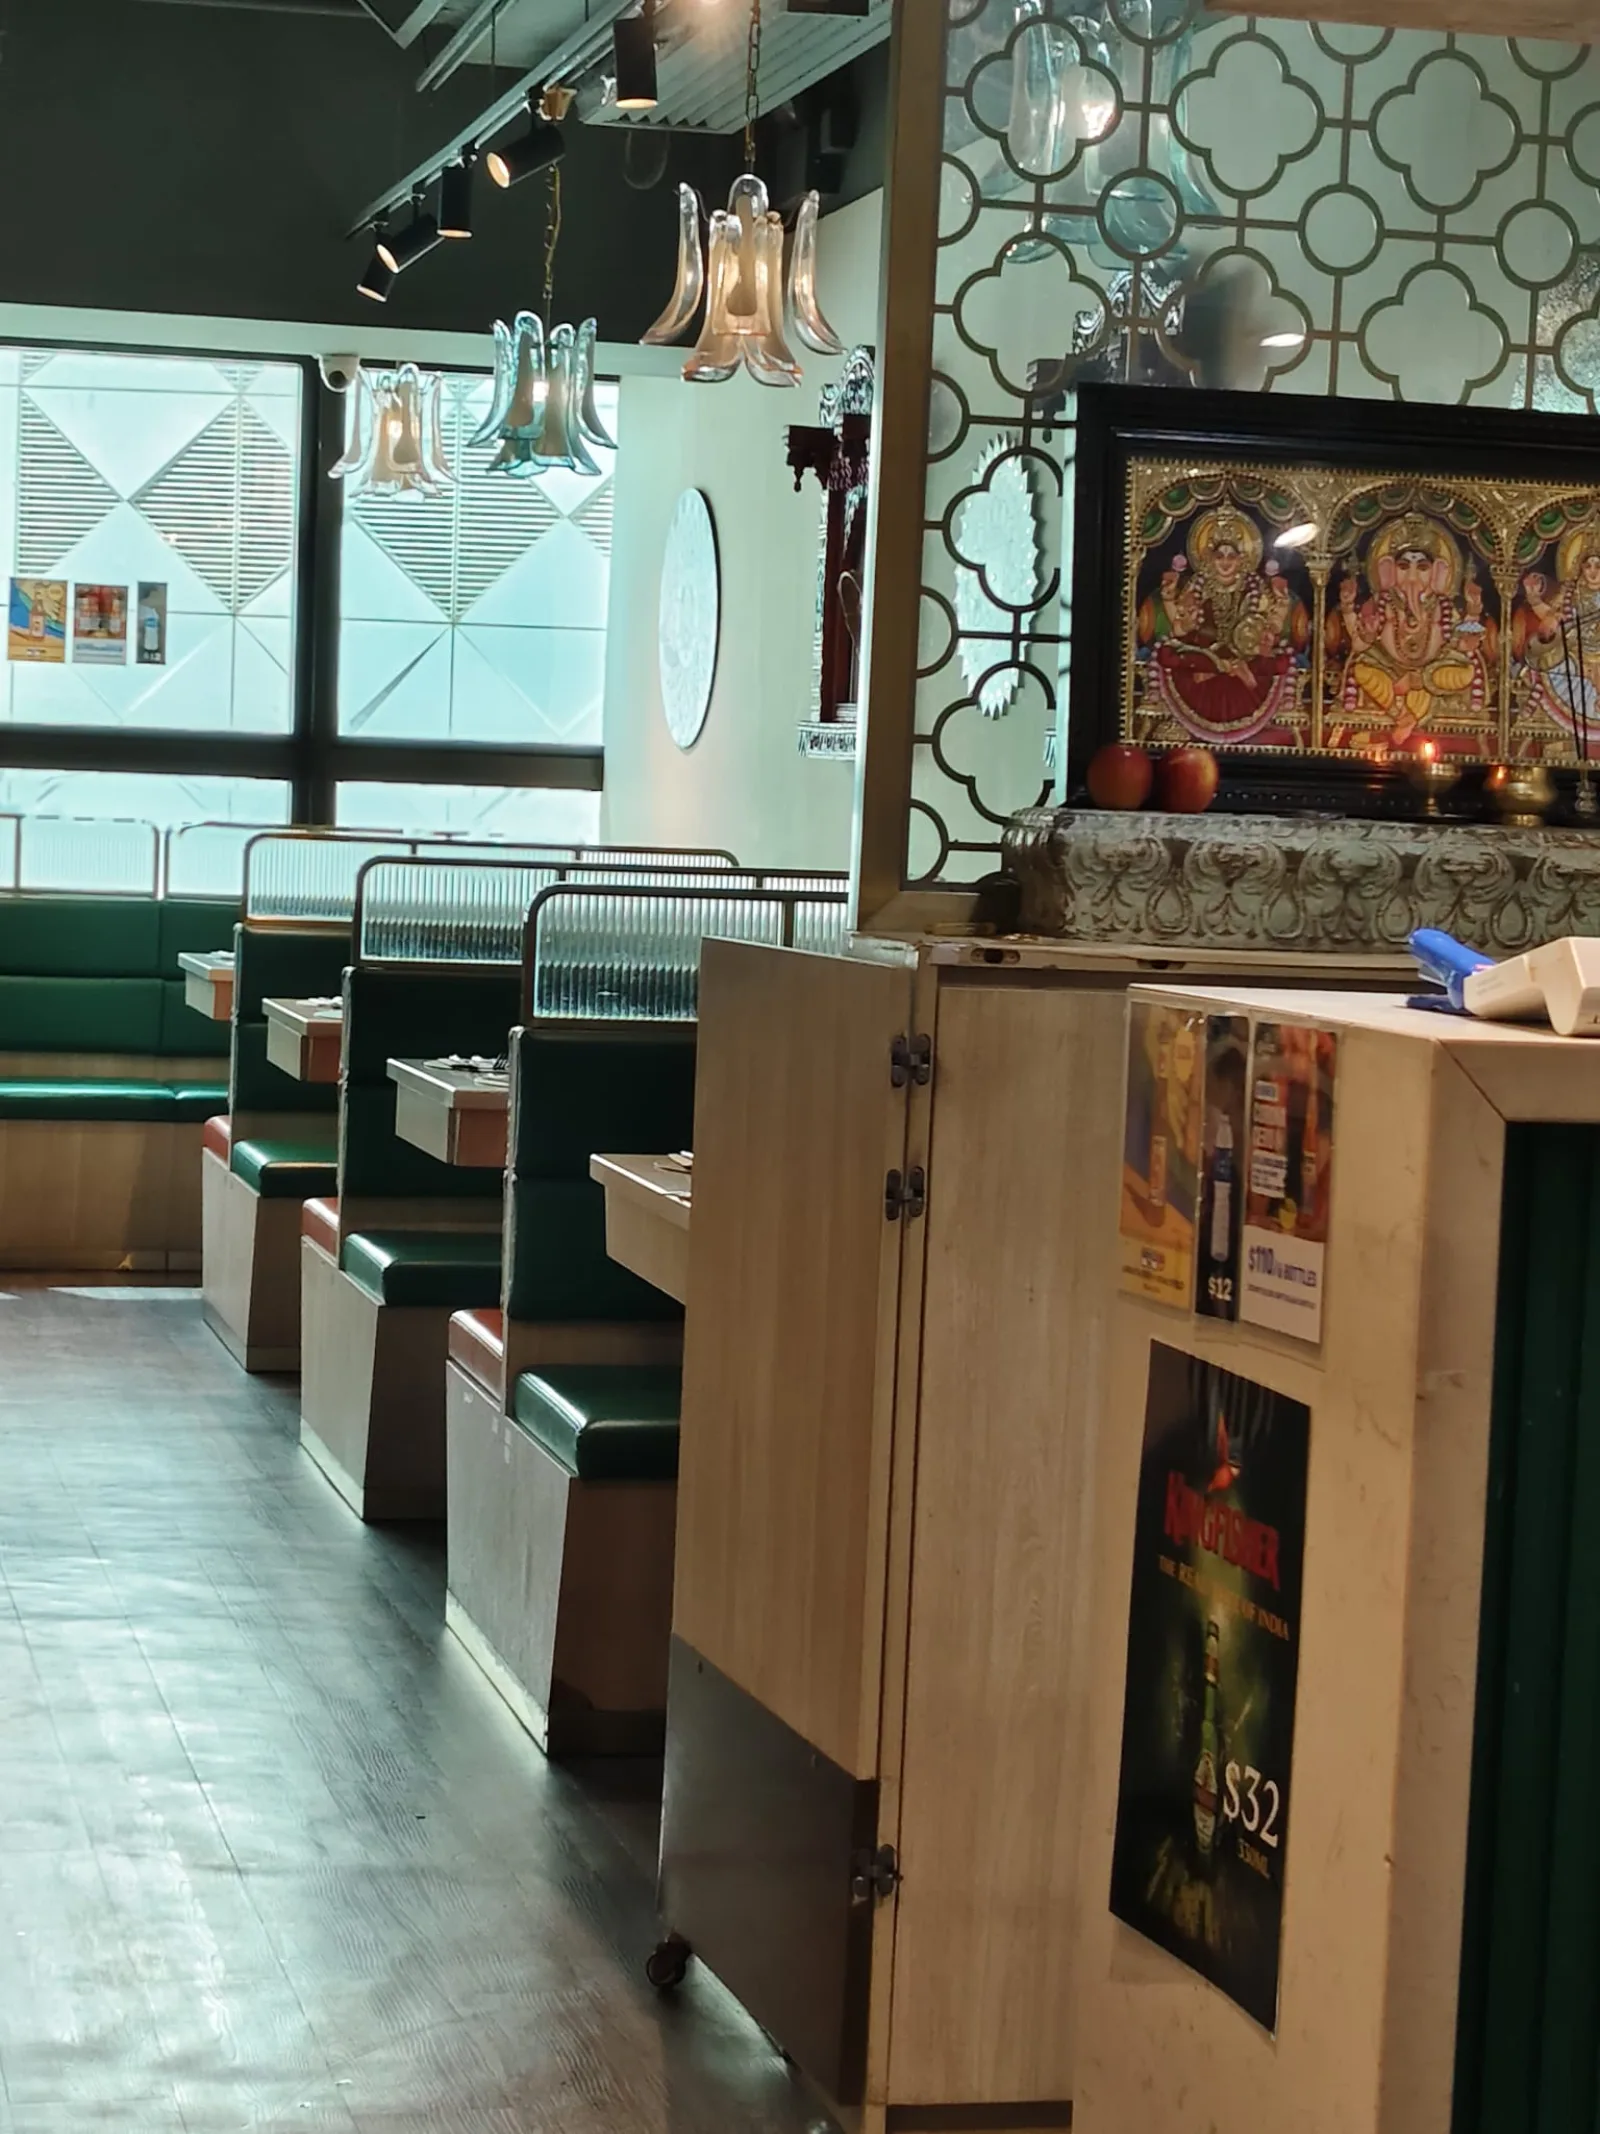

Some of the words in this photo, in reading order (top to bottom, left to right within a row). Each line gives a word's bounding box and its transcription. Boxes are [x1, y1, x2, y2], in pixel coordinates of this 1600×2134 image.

[1207, 1275, 1233, 1302] $12
[1258, 1607, 1289, 1641] INDIA
[1223, 1759, 1279, 1848] $32
